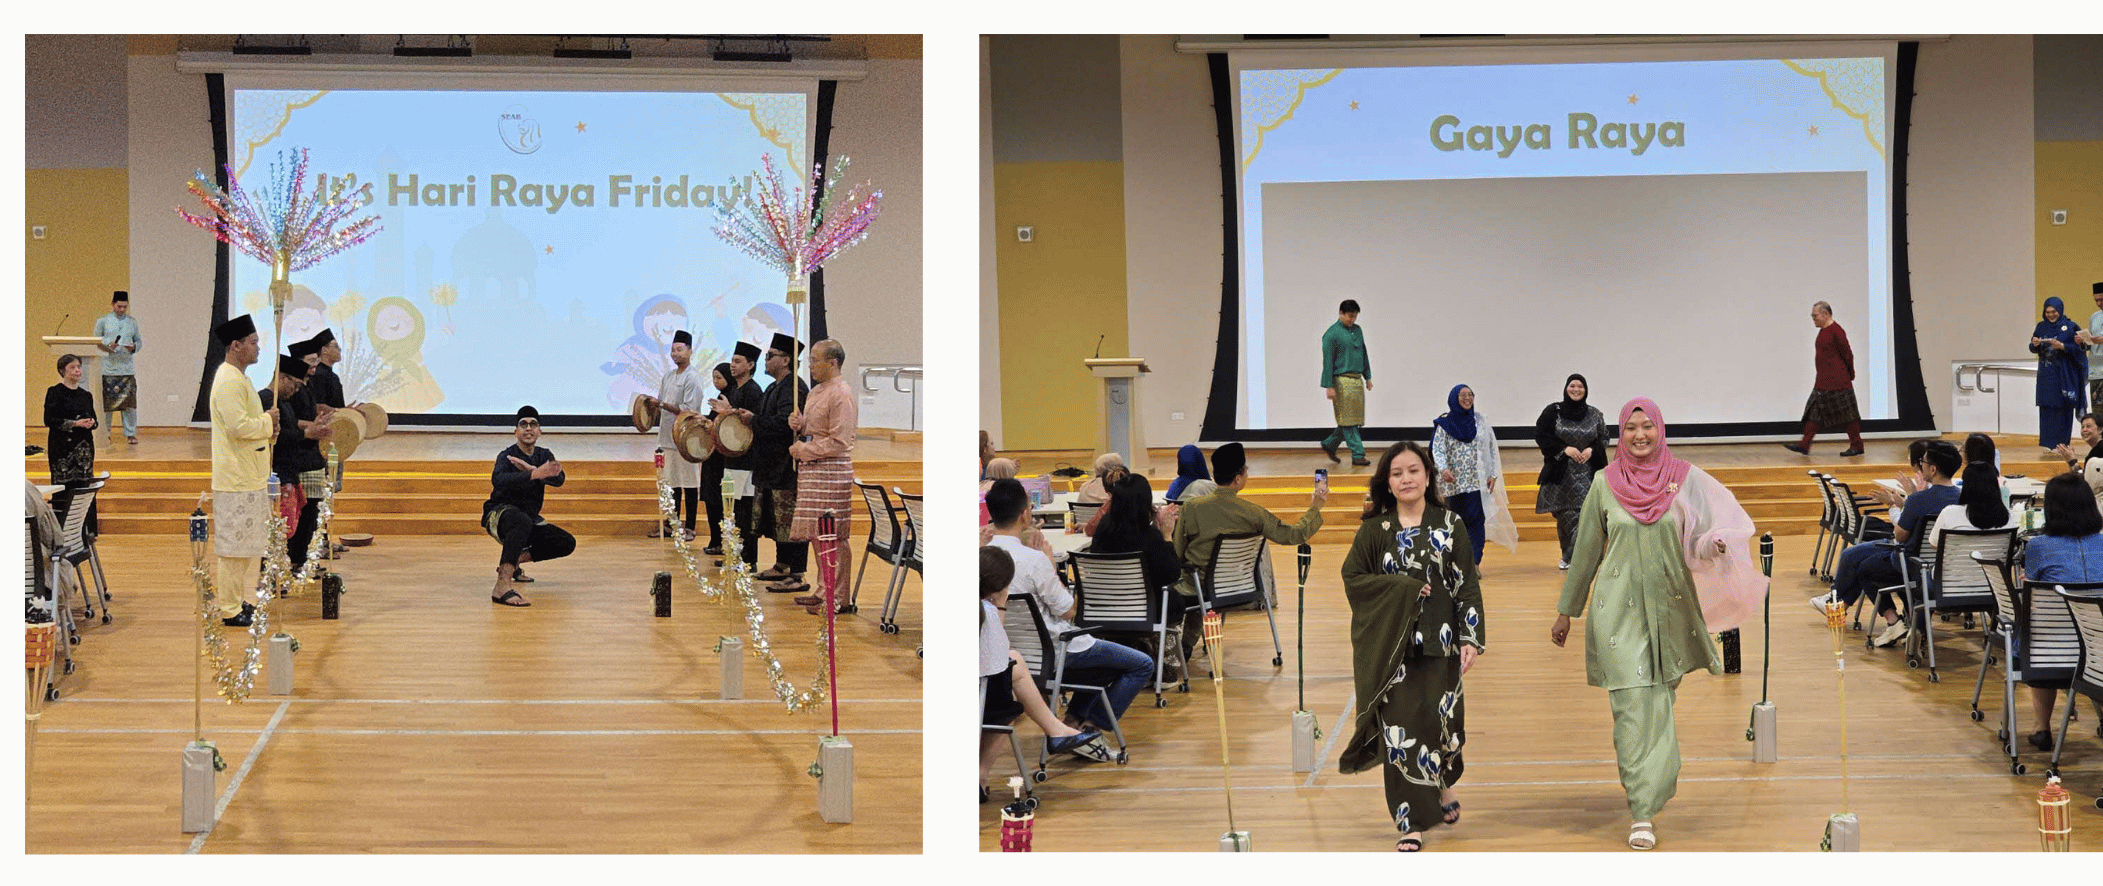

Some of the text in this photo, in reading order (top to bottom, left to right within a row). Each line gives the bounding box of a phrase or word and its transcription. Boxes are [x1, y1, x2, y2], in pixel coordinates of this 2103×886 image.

[1429, 112, 1685, 158] Gaya Raya
[388, 173, 476, 206] Hari
[491, 174, 594, 214] Raya
[608, 174, 752, 214] Friday!
